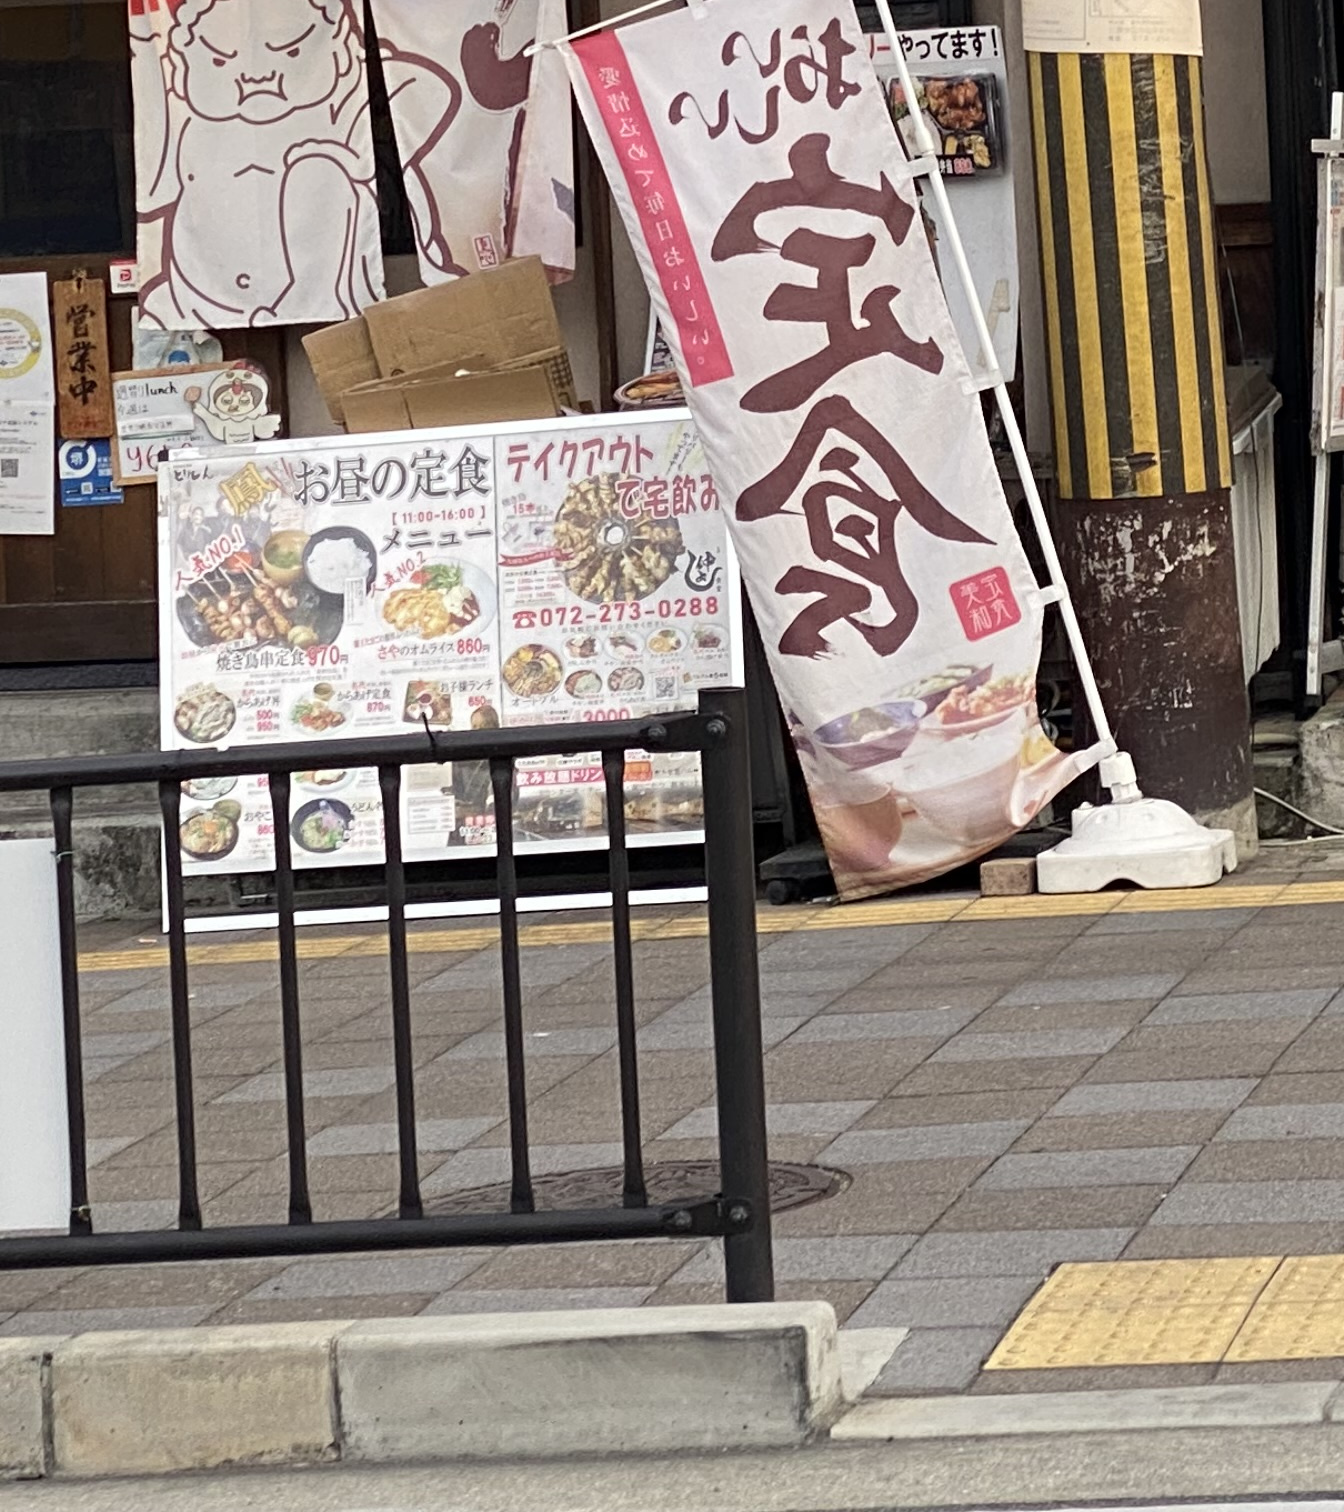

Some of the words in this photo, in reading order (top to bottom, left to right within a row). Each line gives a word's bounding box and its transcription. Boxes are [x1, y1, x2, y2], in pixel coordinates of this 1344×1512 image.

[66, 305, 98, 406] 営業中
[293, 444, 491, 507] お昼の定食
[507, 434, 654, 483] テイクアウト
[615, 473, 720, 519] で宅飲み
[381, 528, 493, 554] メニュー
[540, 595, 719, 628] 072-273-0288
